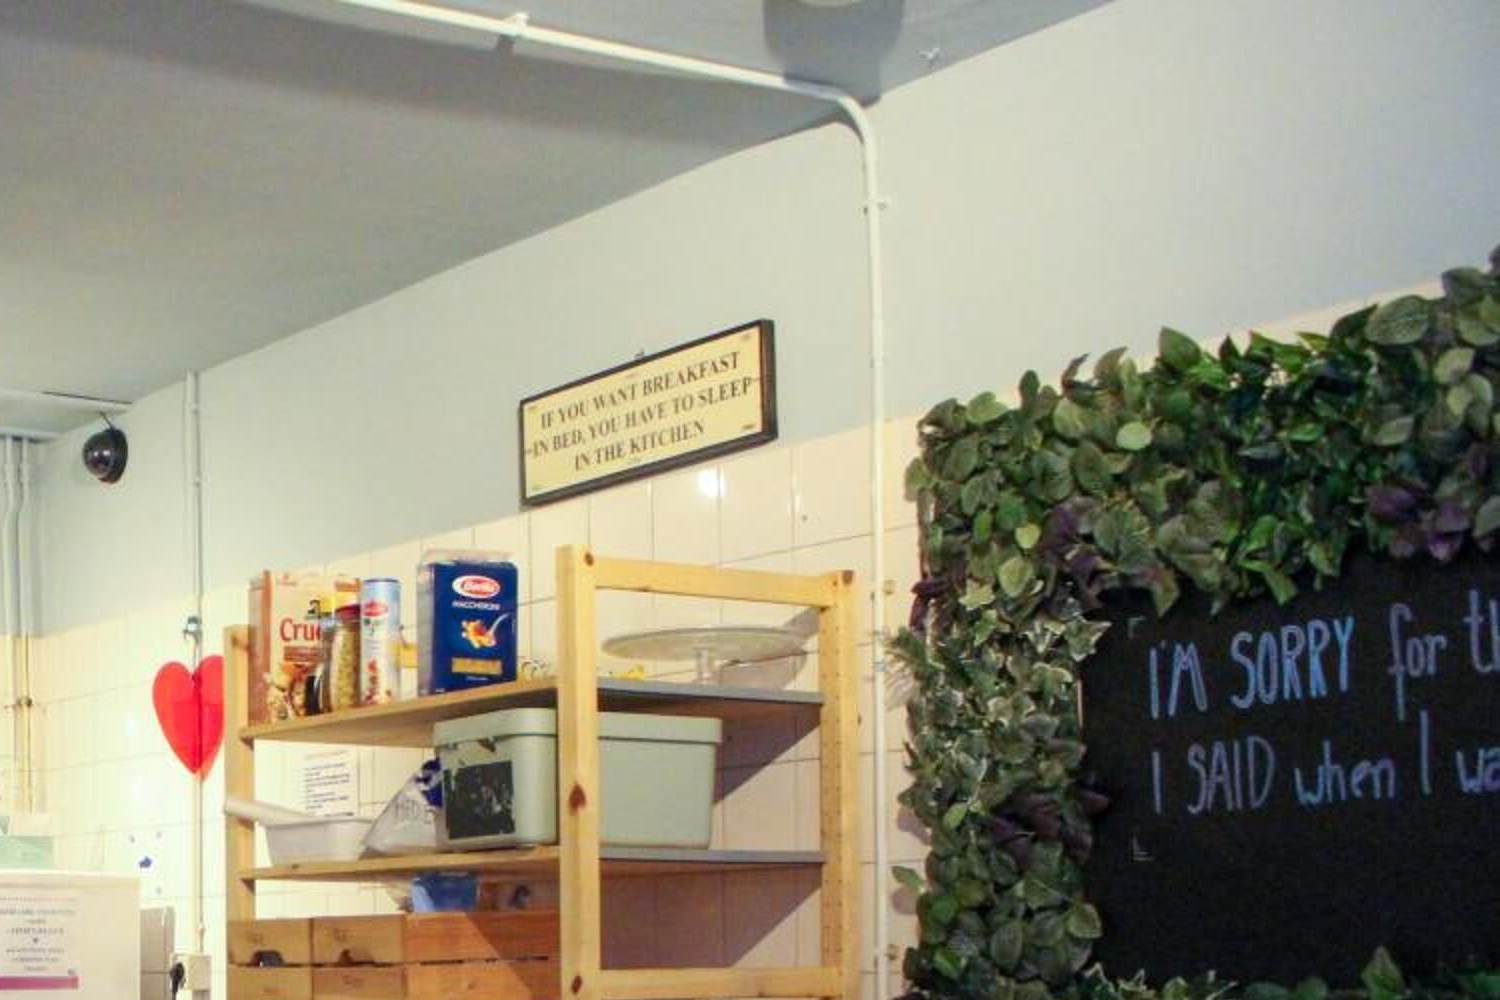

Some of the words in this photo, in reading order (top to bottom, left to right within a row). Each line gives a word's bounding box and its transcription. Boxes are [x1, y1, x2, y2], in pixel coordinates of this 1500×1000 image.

[532, 438, 550, 458] IN
[586, 415, 622, 443] YOU
[624, 402, 669, 429] HAVE
[671, 393, 697, 416] TO
[700, 375, 753, 410] SLEEP
[540, 410, 555, 430] IF
[556, 400, 590, 425] YOU
[591, 382, 640, 413] WANT
[643, 350, 740, 398] BREAKFAST
[573, 450, 592, 472] IN
[592, 441, 627, 464] THE
[629, 419, 706, 457] KITCHEN
[1149, 639, 1208, 720] I'M
[1230, 615, 1355, 710] SORRY
[1388, 602, 1447, 722] for
[1150, 750, 1163, 815] I
[1187, 734, 1276, 815] SAID
[1294, 739, 1397, 805] when
[1419, 708, 1433, 796] I
